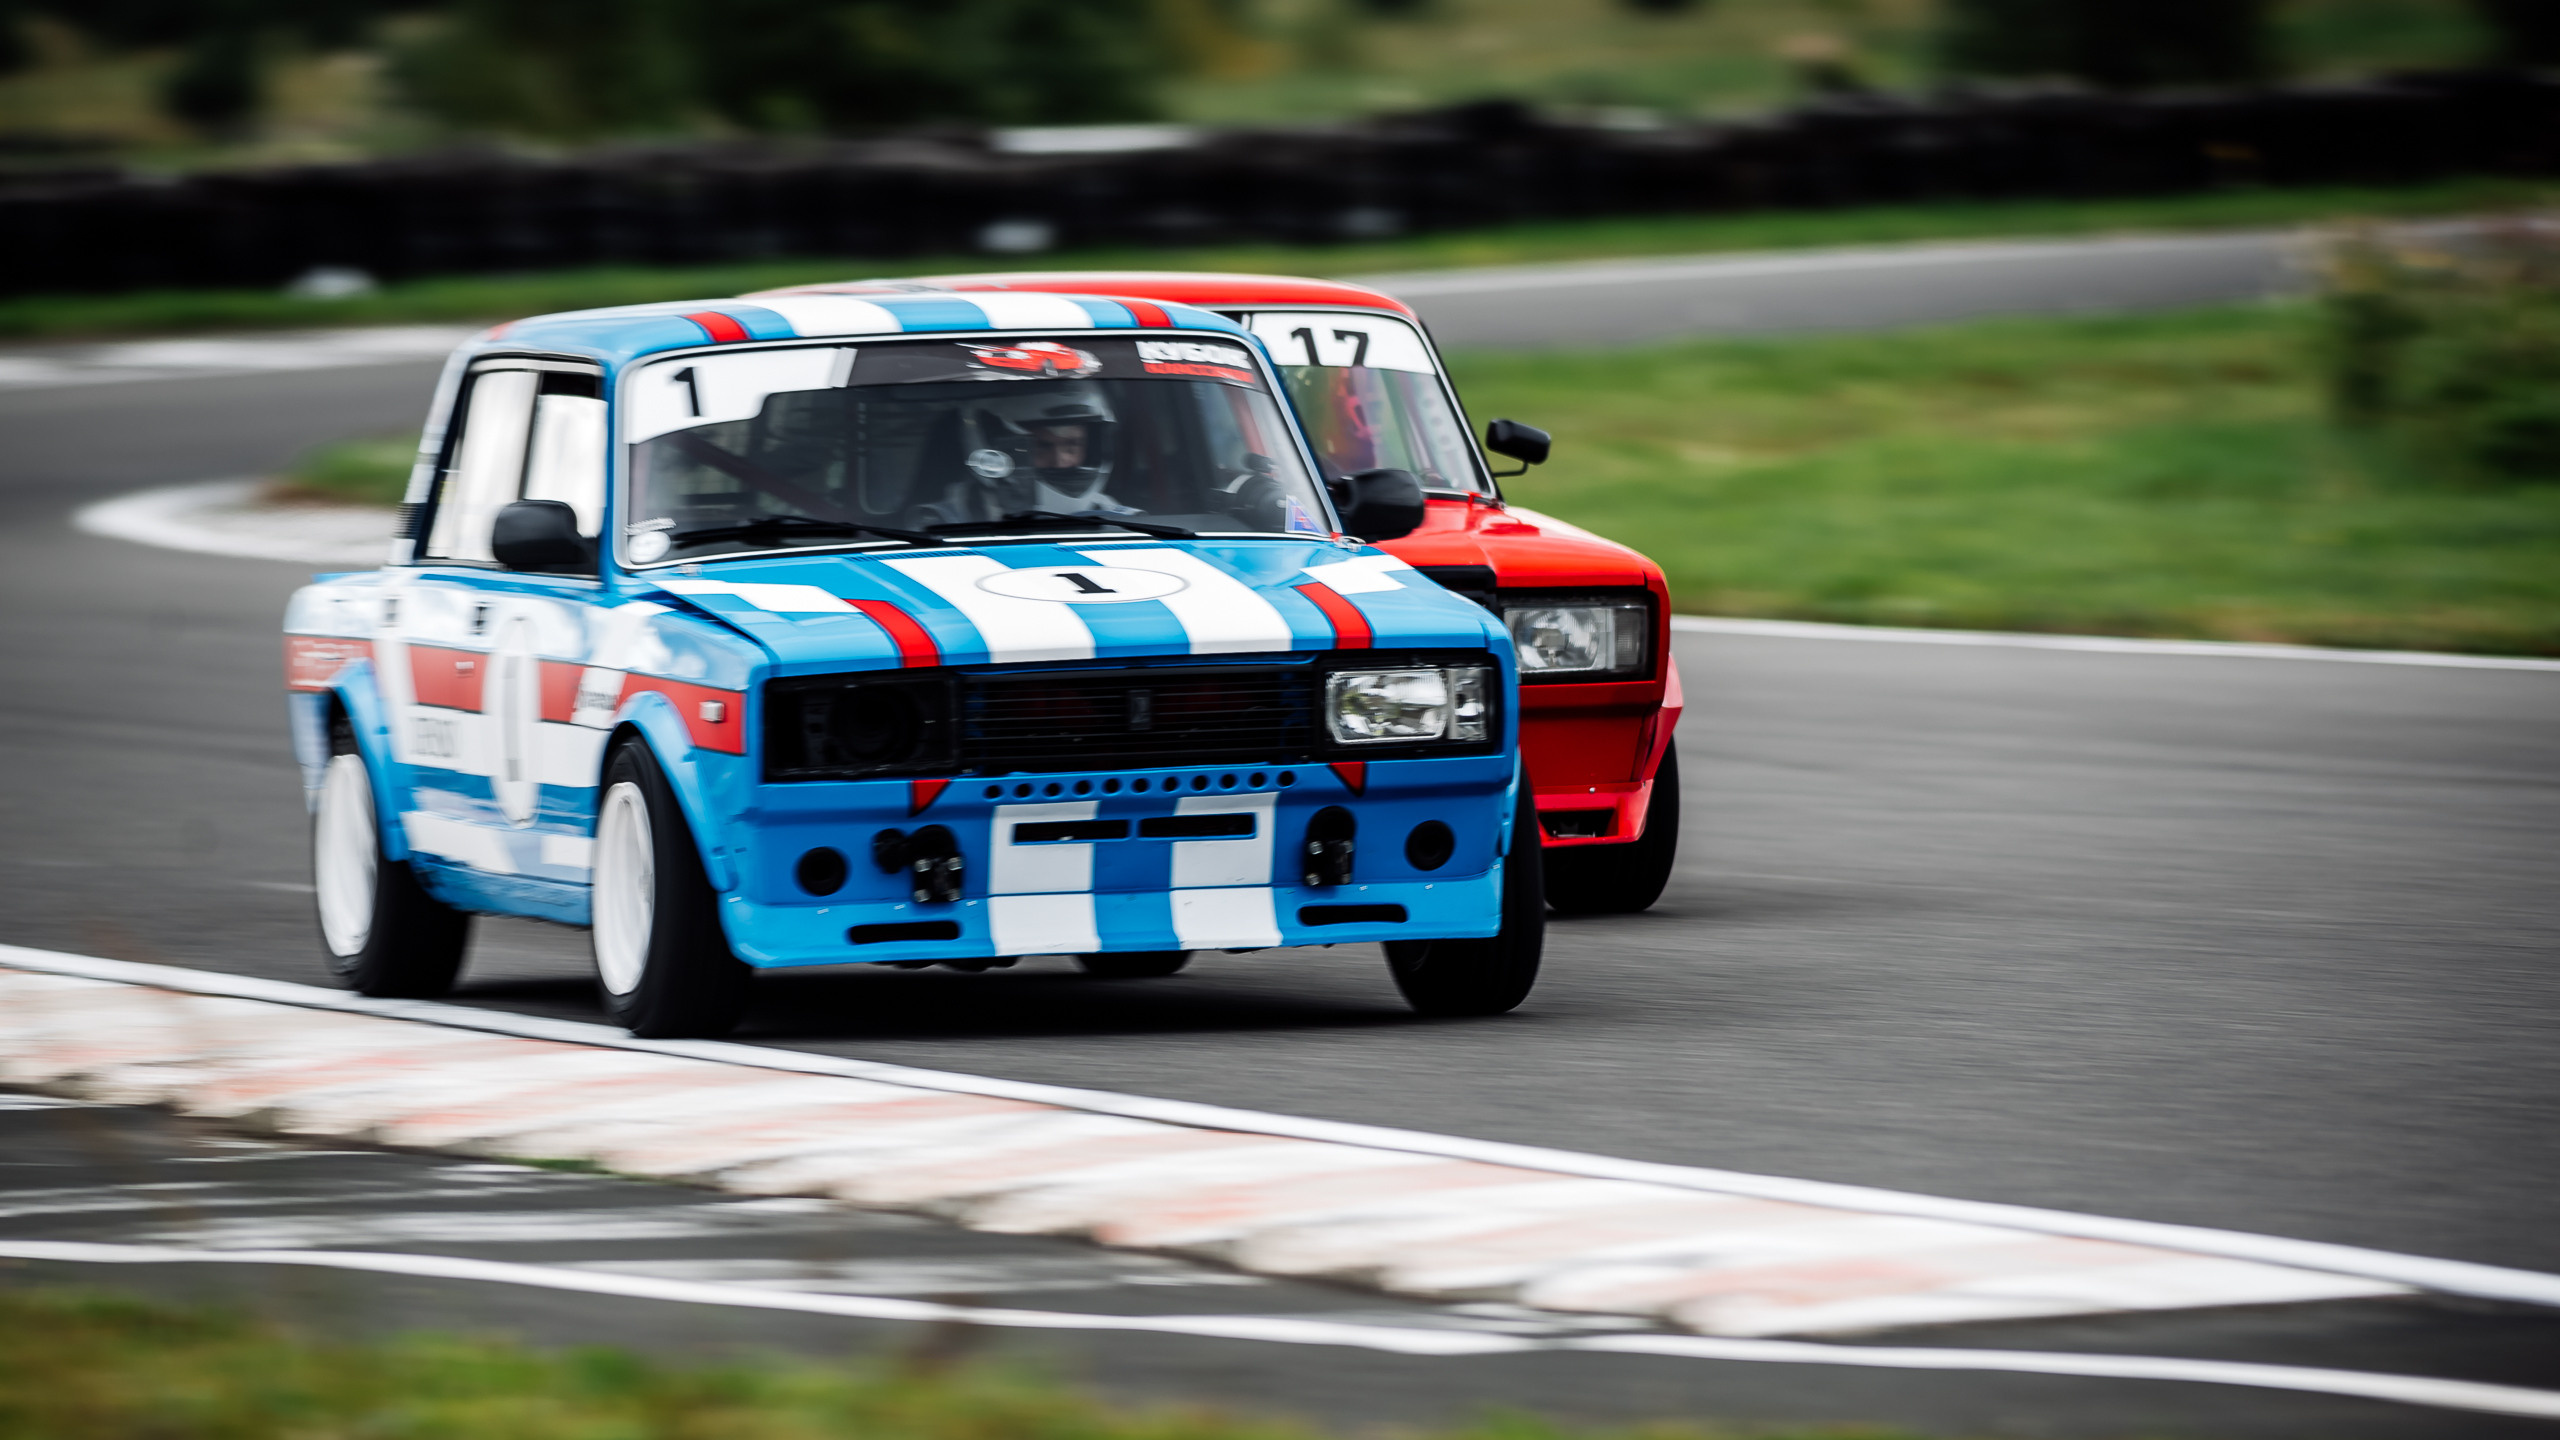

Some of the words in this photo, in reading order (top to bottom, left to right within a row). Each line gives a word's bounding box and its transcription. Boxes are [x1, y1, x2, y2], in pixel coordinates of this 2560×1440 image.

[1290, 327, 1369, 367] 17
[672, 366, 702, 417] 1
[1051, 572, 1118, 595] 1
